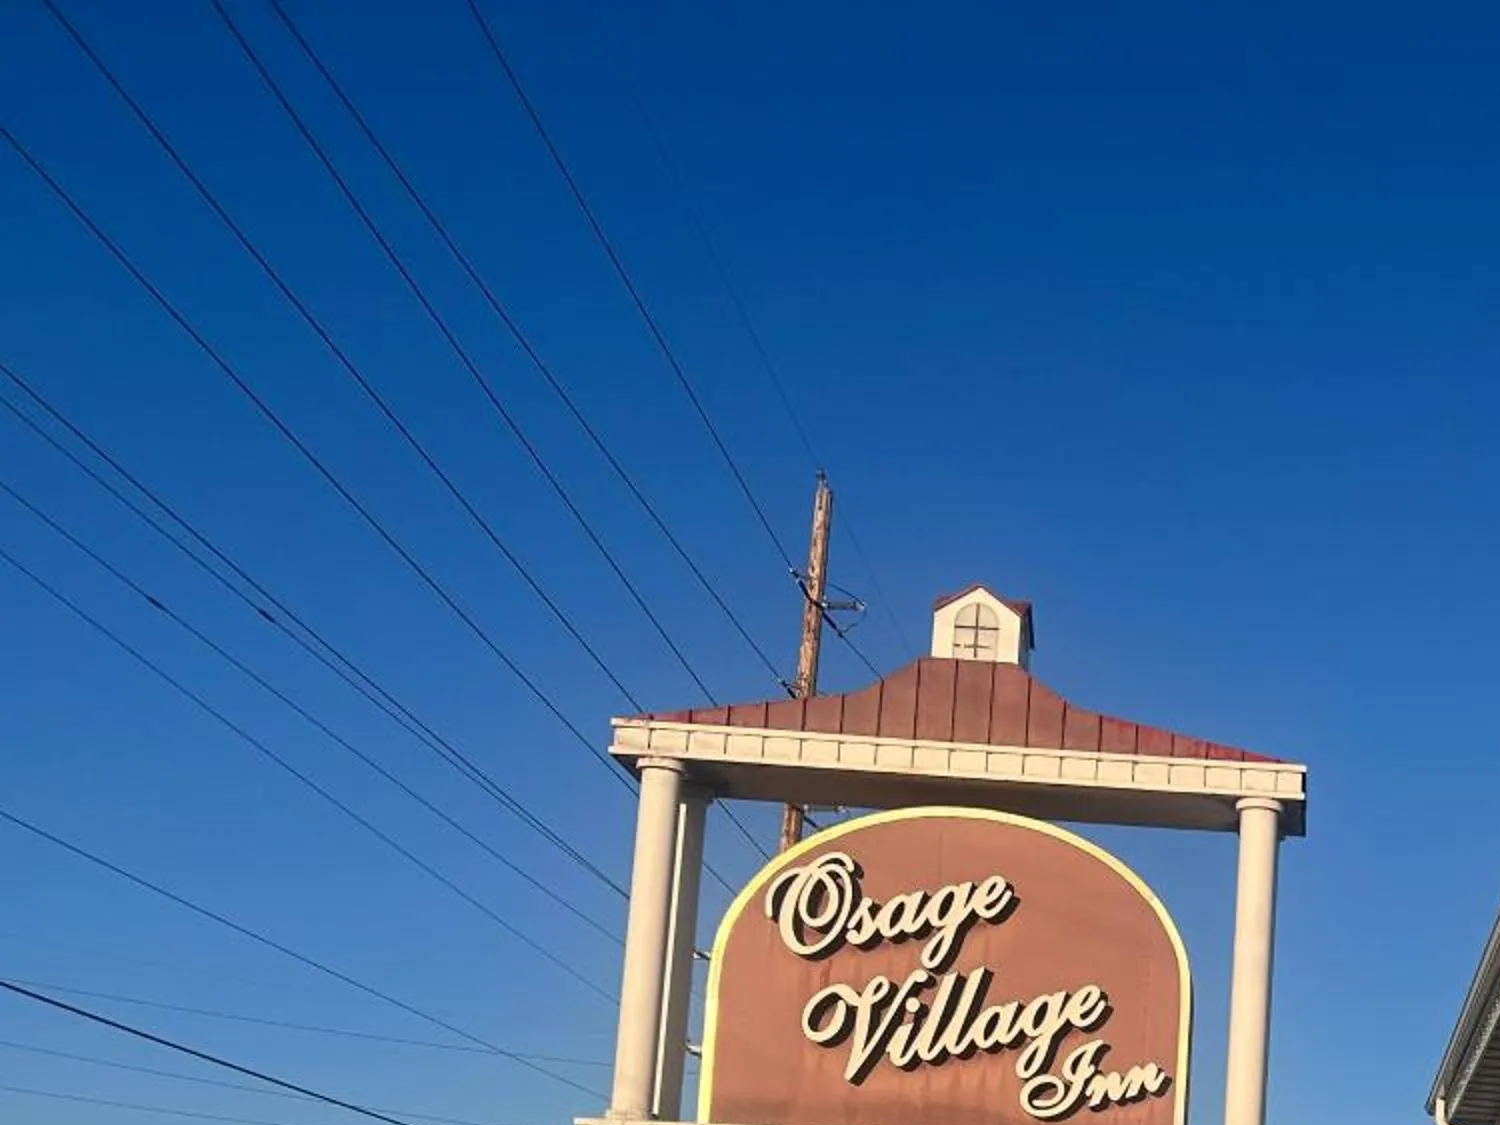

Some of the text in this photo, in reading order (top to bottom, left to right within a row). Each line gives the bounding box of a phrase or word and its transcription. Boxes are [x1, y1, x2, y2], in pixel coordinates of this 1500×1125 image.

[765, 851, 1018, 970] Osage
[801, 967, 1112, 1086] Village
[1019, 1040, 1170, 1120] Inn
